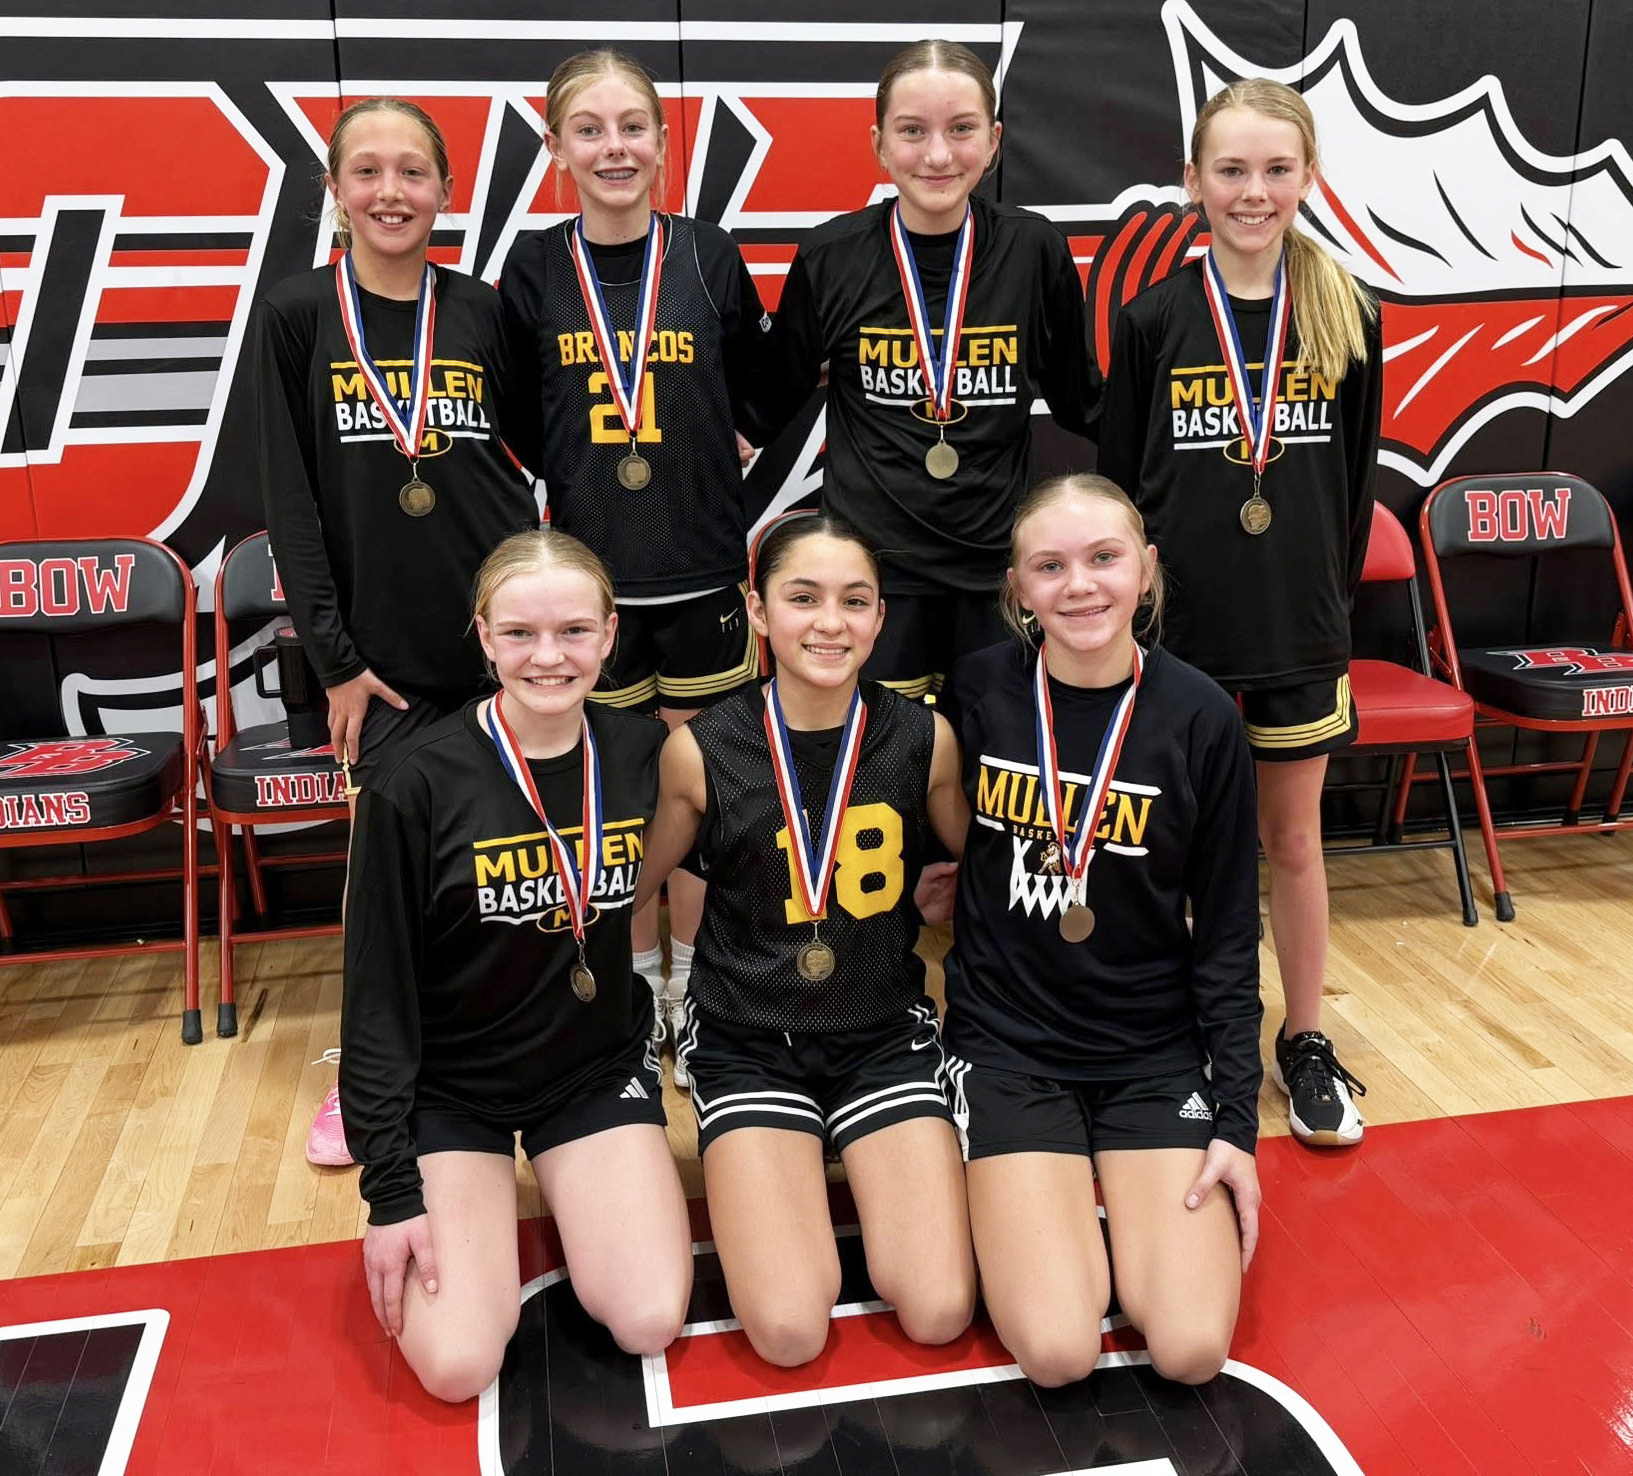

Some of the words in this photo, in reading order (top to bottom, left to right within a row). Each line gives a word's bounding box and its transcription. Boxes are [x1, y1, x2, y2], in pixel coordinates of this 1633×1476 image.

[557, 330, 694, 366] BRNCOS
[859, 336, 1018, 369] MUEN
[860, 365, 1017, 396] BASKBALL
[1171, 372, 1338, 409] MUEN
[335, 398, 491, 431] BASTBALL
[588, 371, 662, 443] 21
[1172, 401, 1333, 438] BASKBALL
[1465, 488, 1571, 542] BOW
[0, 553, 136, 618] BOW
[0, 791, 91, 829] IANS
[776, 802, 904, 925] 18
[477, 861, 641, 914] BASKBAL
[1179, 1109, 1213, 1121] adidas
